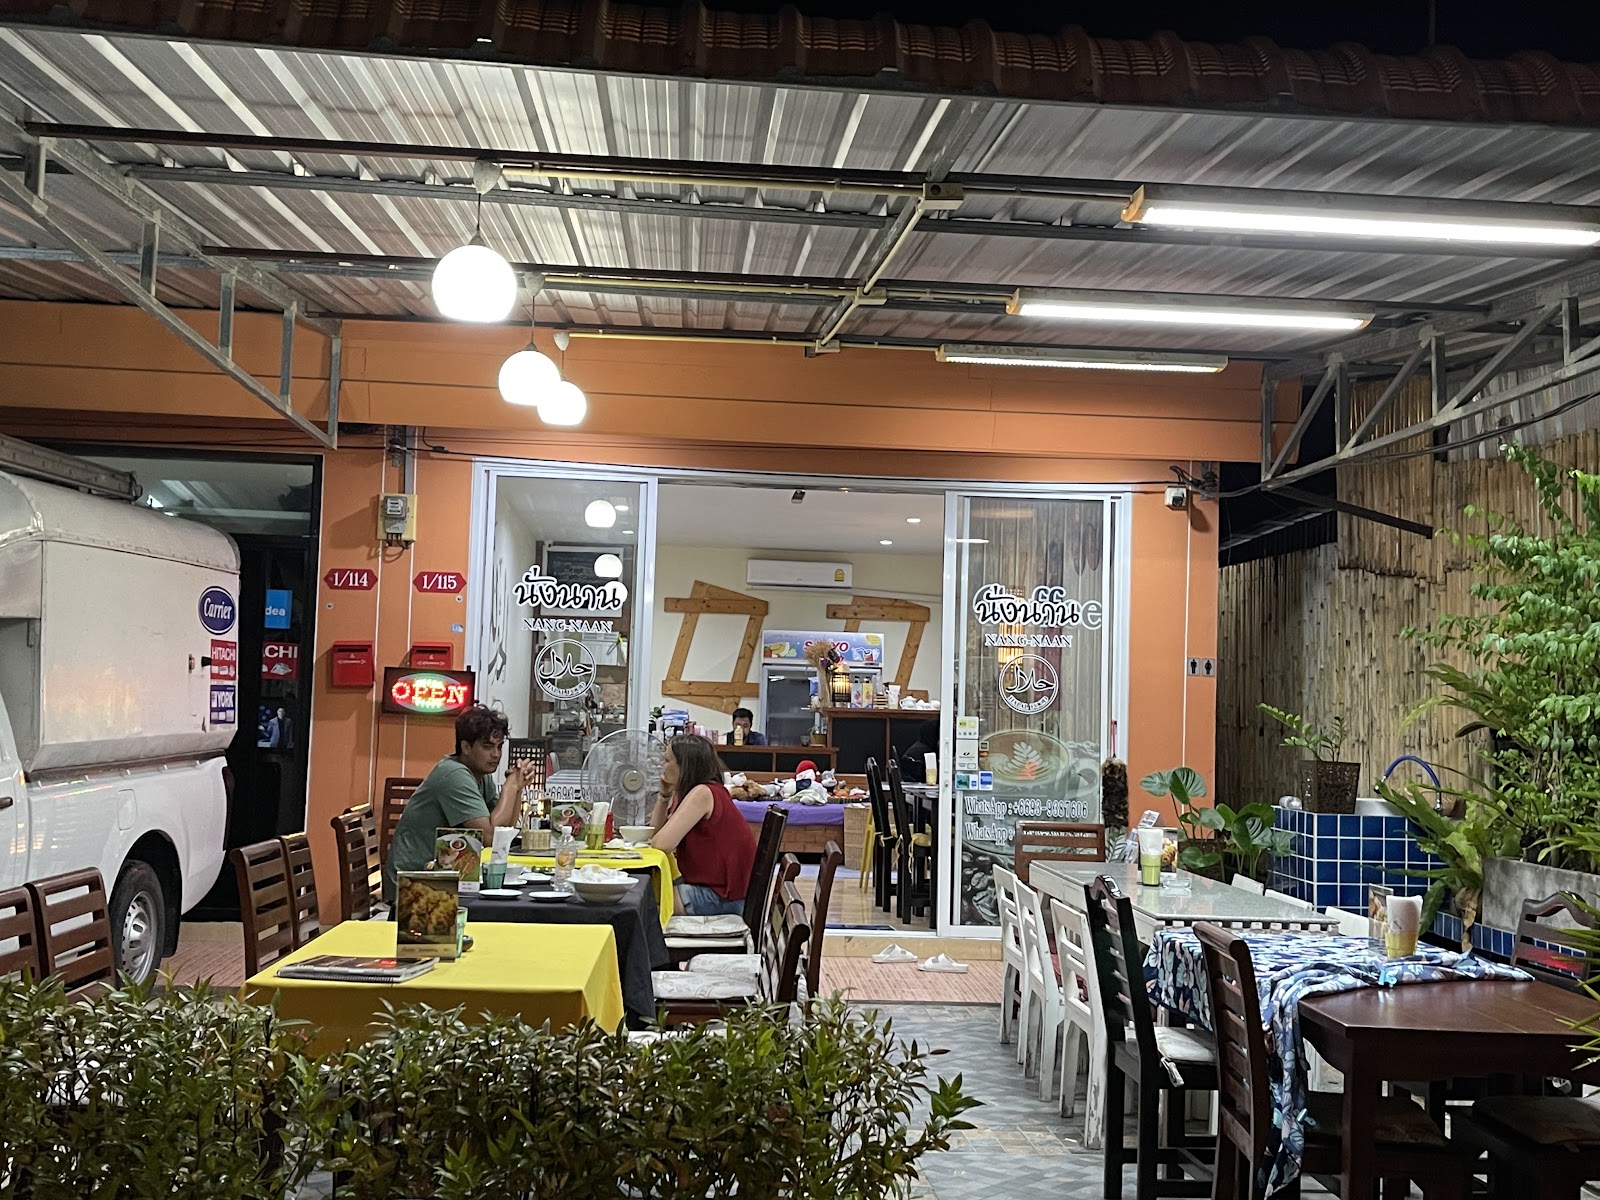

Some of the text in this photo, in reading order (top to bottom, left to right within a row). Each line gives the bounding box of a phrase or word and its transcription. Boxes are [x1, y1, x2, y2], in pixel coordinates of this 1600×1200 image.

[333, 570, 369, 587] 1/114
[422, 573, 458, 590] 1/115
[203, 597, 233, 620] Carrier
[522, 618, 613, 633] NANG-NAAN
[985, 633, 1073, 648] NANG-NAAN
[263, 644, 298, 659] CHI
[391, 680, 468, 705] OPEN
[964, 796, 1007, 819] WhatsApp
[965, 822, 1007, 845] WhatsApp
